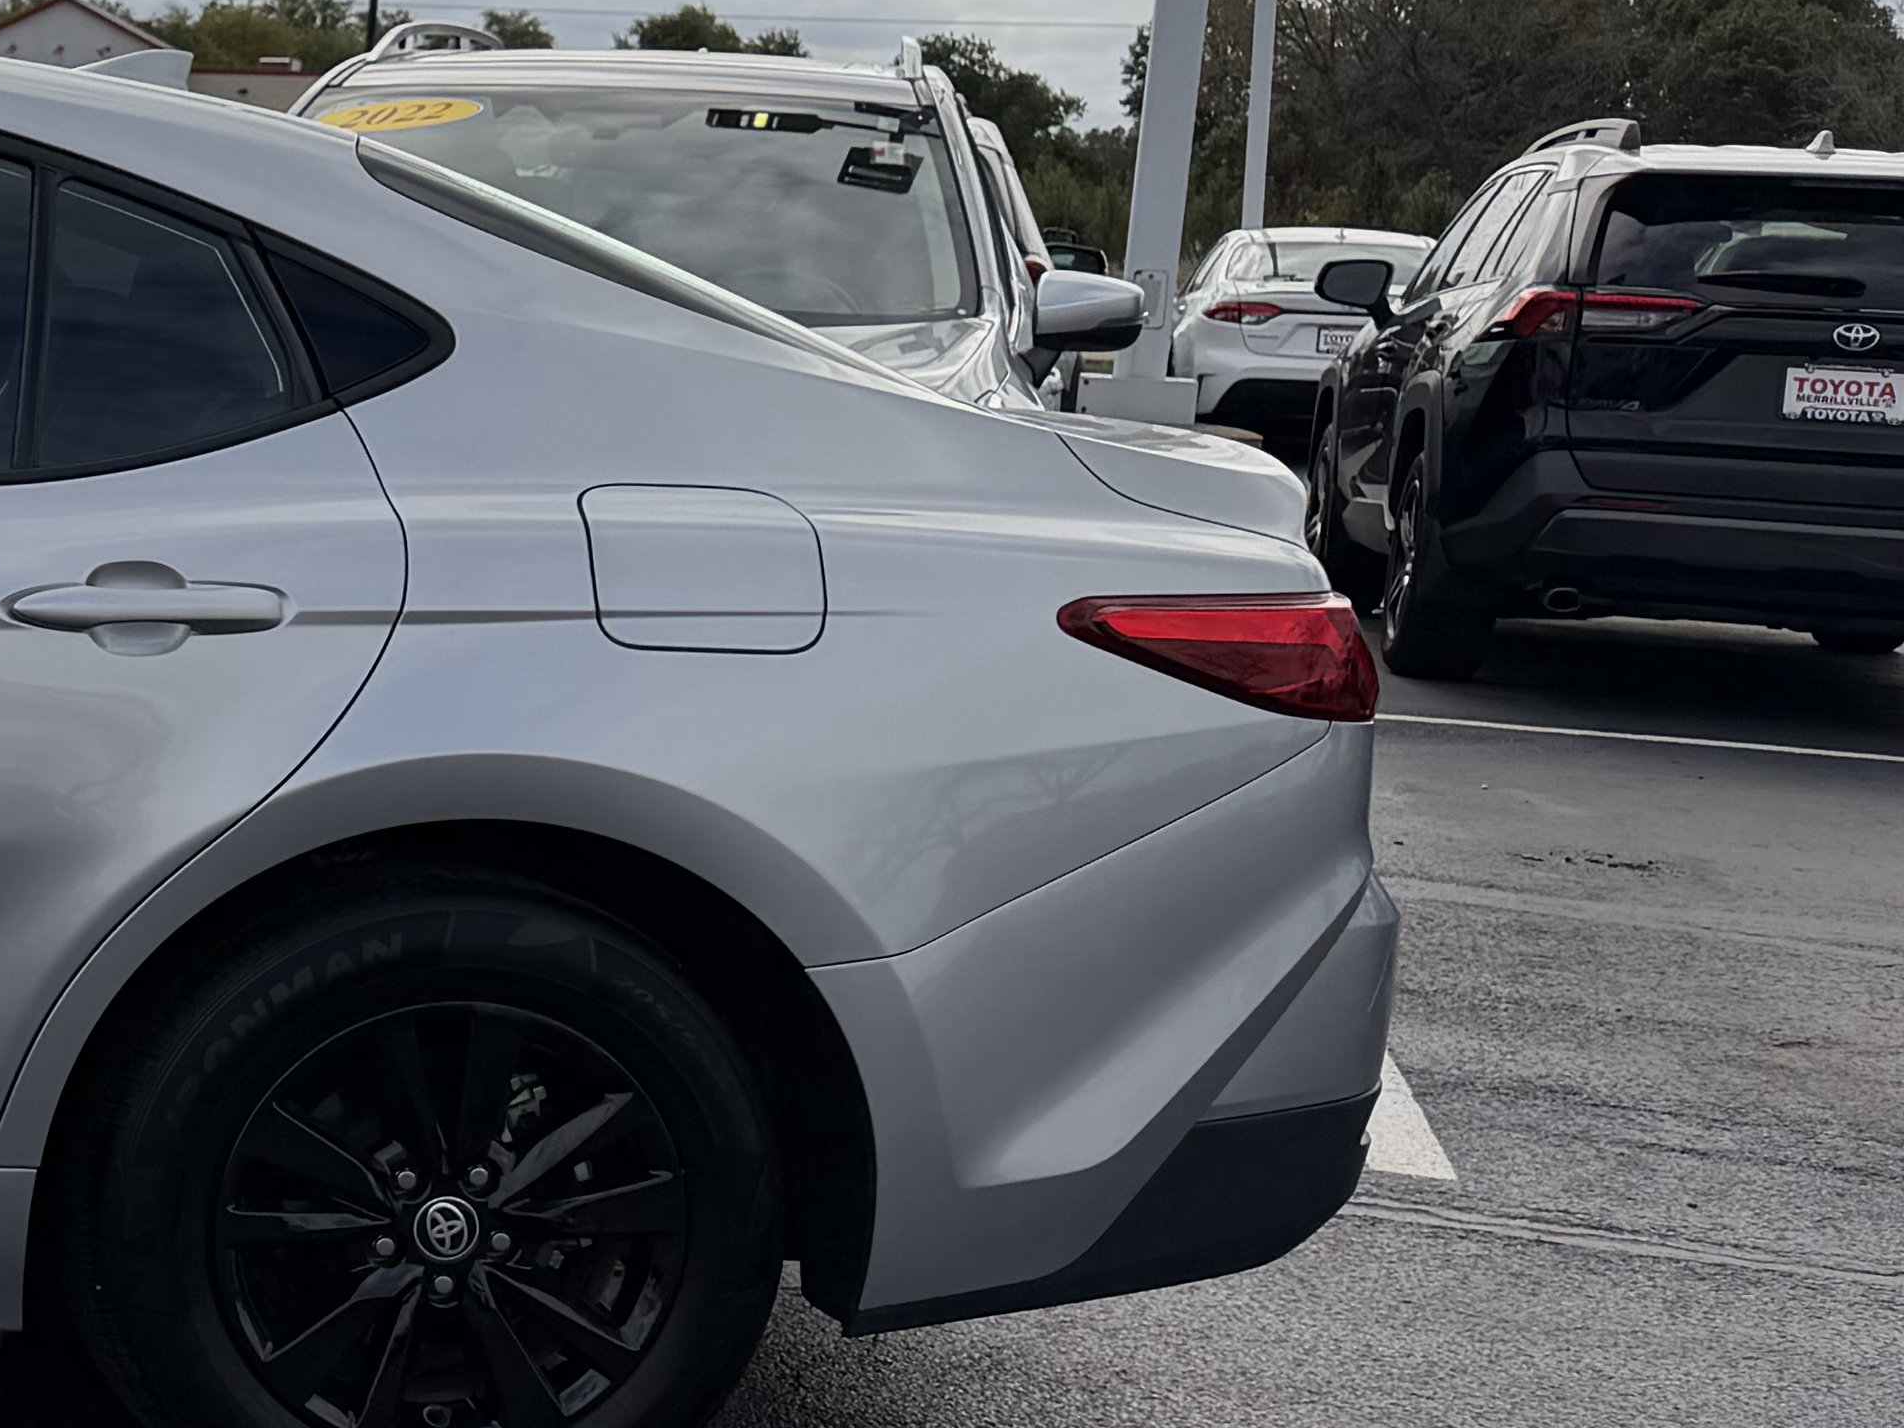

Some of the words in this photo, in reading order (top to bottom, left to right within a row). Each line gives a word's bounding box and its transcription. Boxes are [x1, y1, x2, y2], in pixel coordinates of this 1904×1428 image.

[338, 101, 453, 129] 2022
[1793, 376, 1896, 399] TOYOTA
[1795, 393, 1881, 408] MERRILLVILLE
[1803, 408, 1870, 423] TOYOTA
